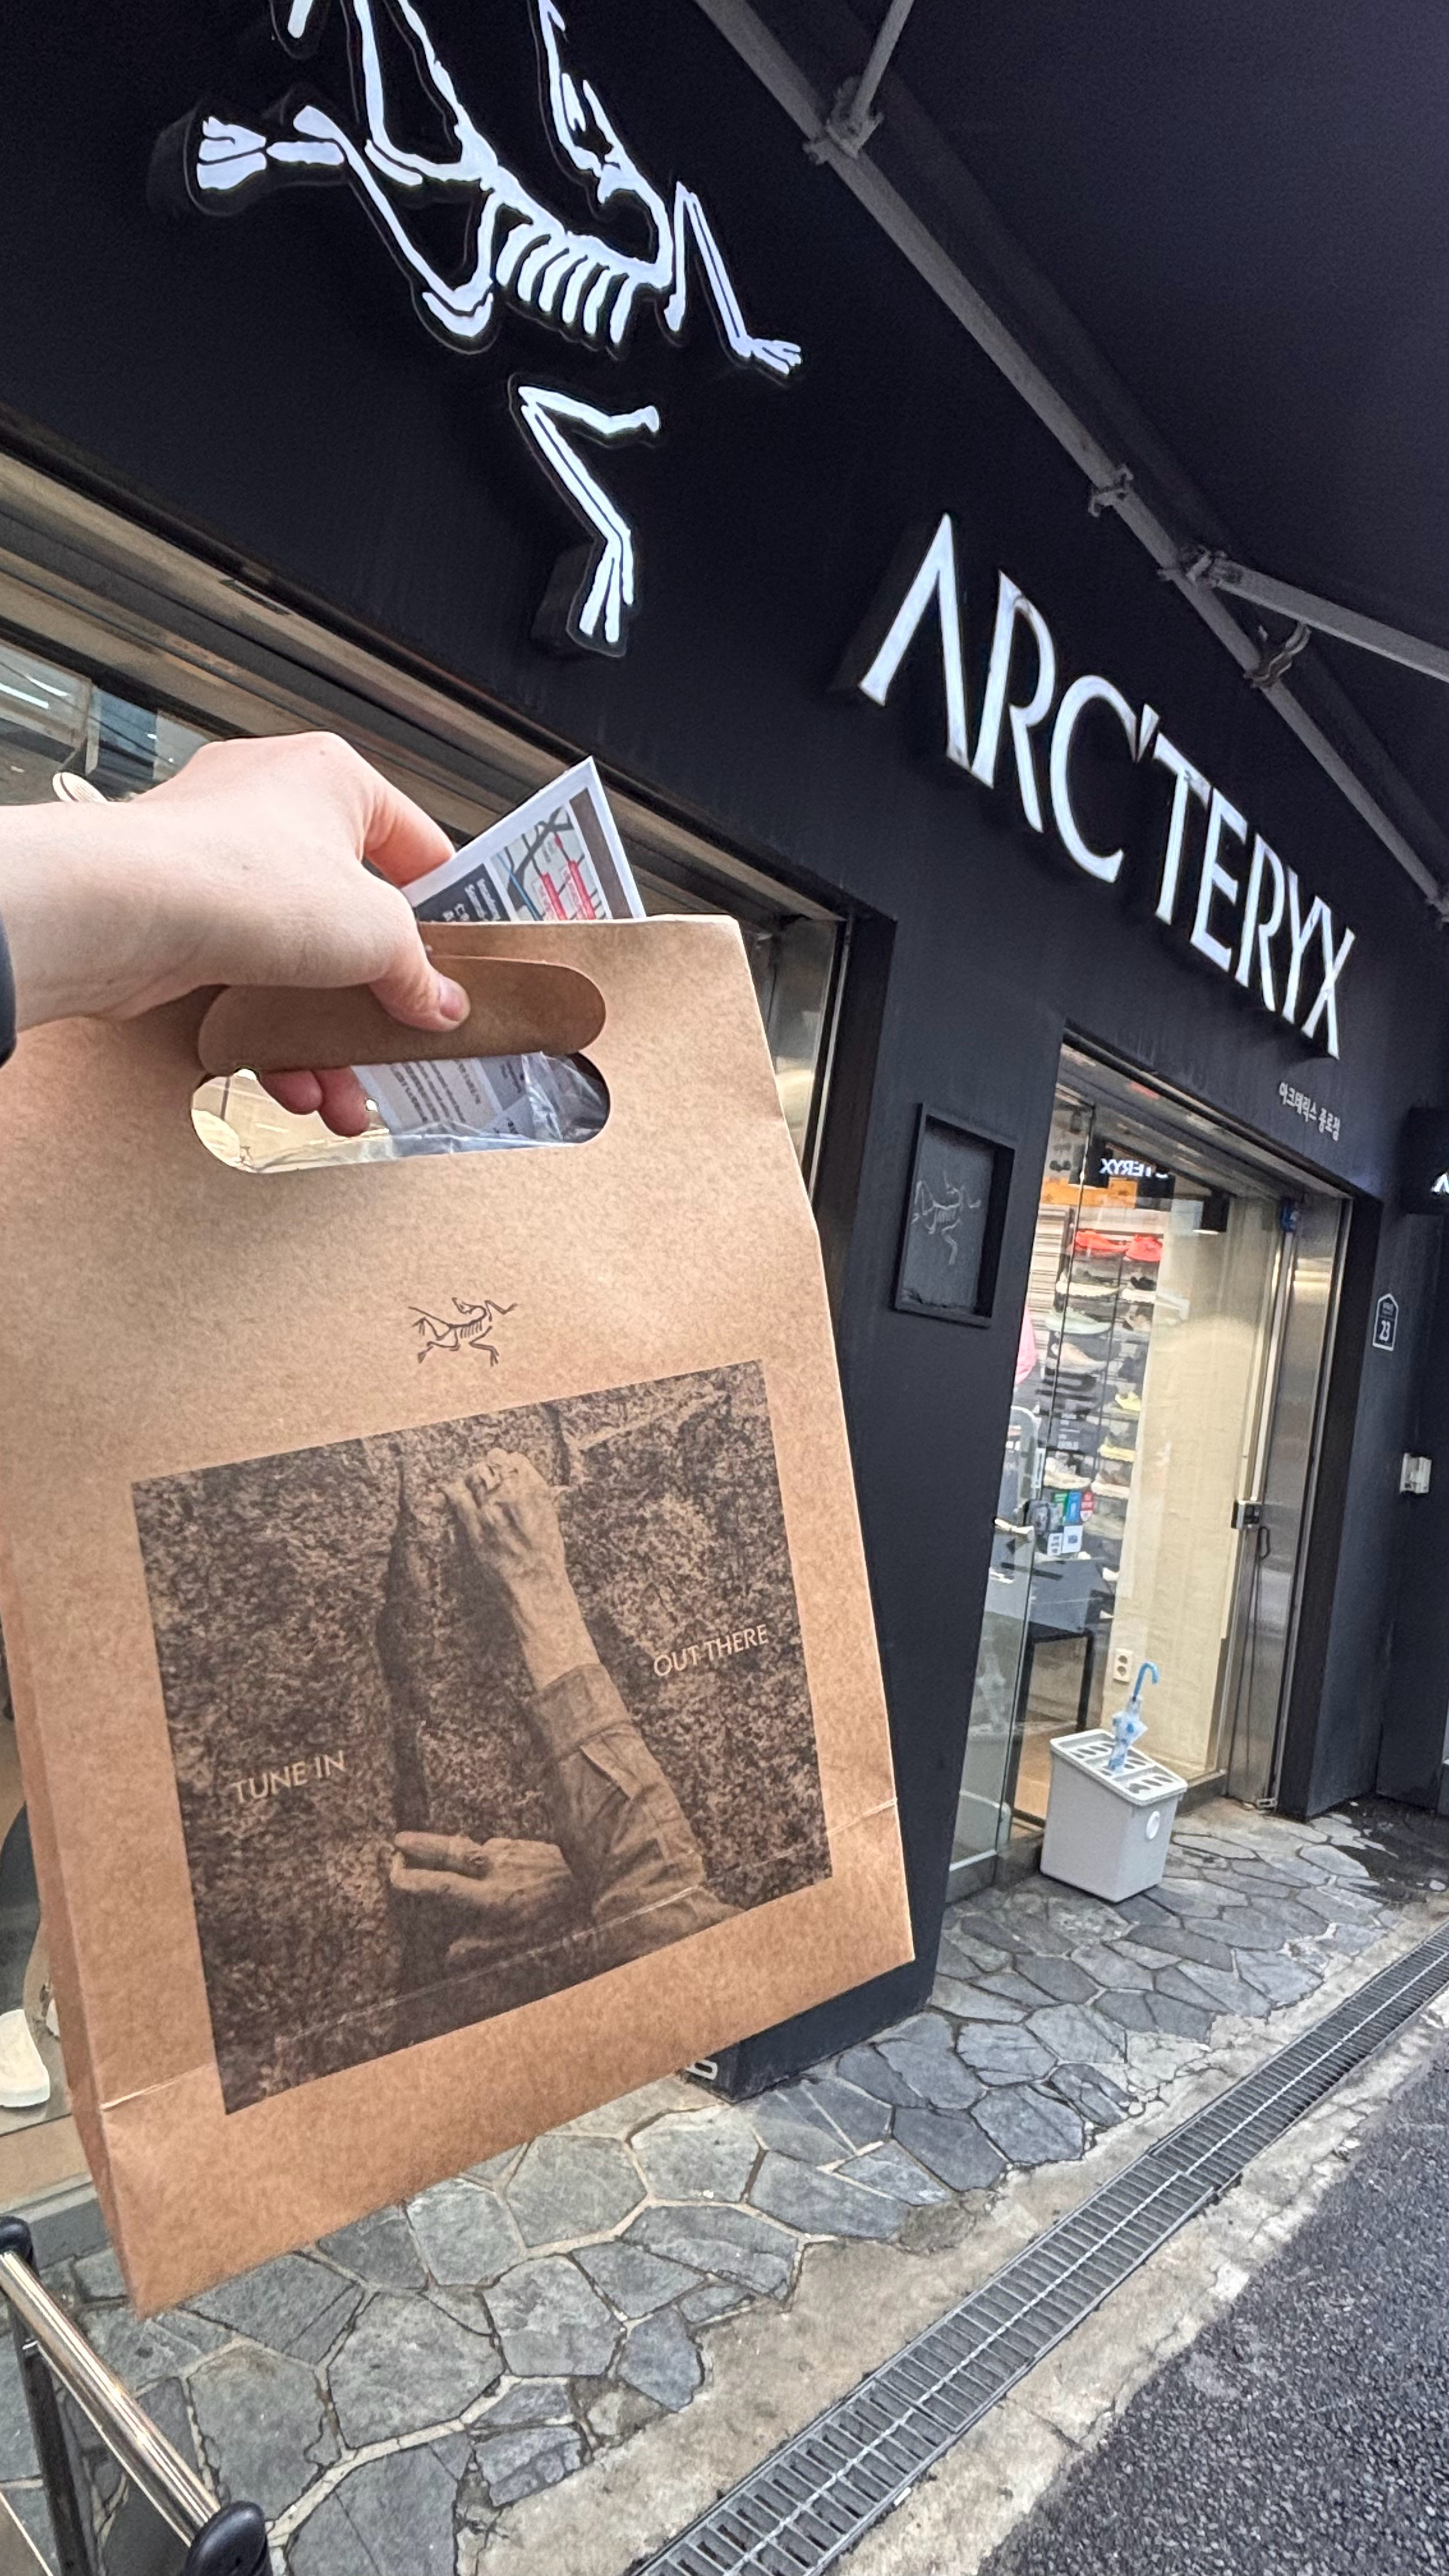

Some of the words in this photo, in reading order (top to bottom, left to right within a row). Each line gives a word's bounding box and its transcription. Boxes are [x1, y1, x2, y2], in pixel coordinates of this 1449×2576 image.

[858, 513, 1356, 1059] ARC'TERYX
[1379, 1320, 1391, 1342] 23
[654, 1644, 700, 1677] OUT
[703, 1624, 769, 1662] THERE
[225, 1761, 309, 1804] TUNE
[314, 1750, 347, 1778] IN
